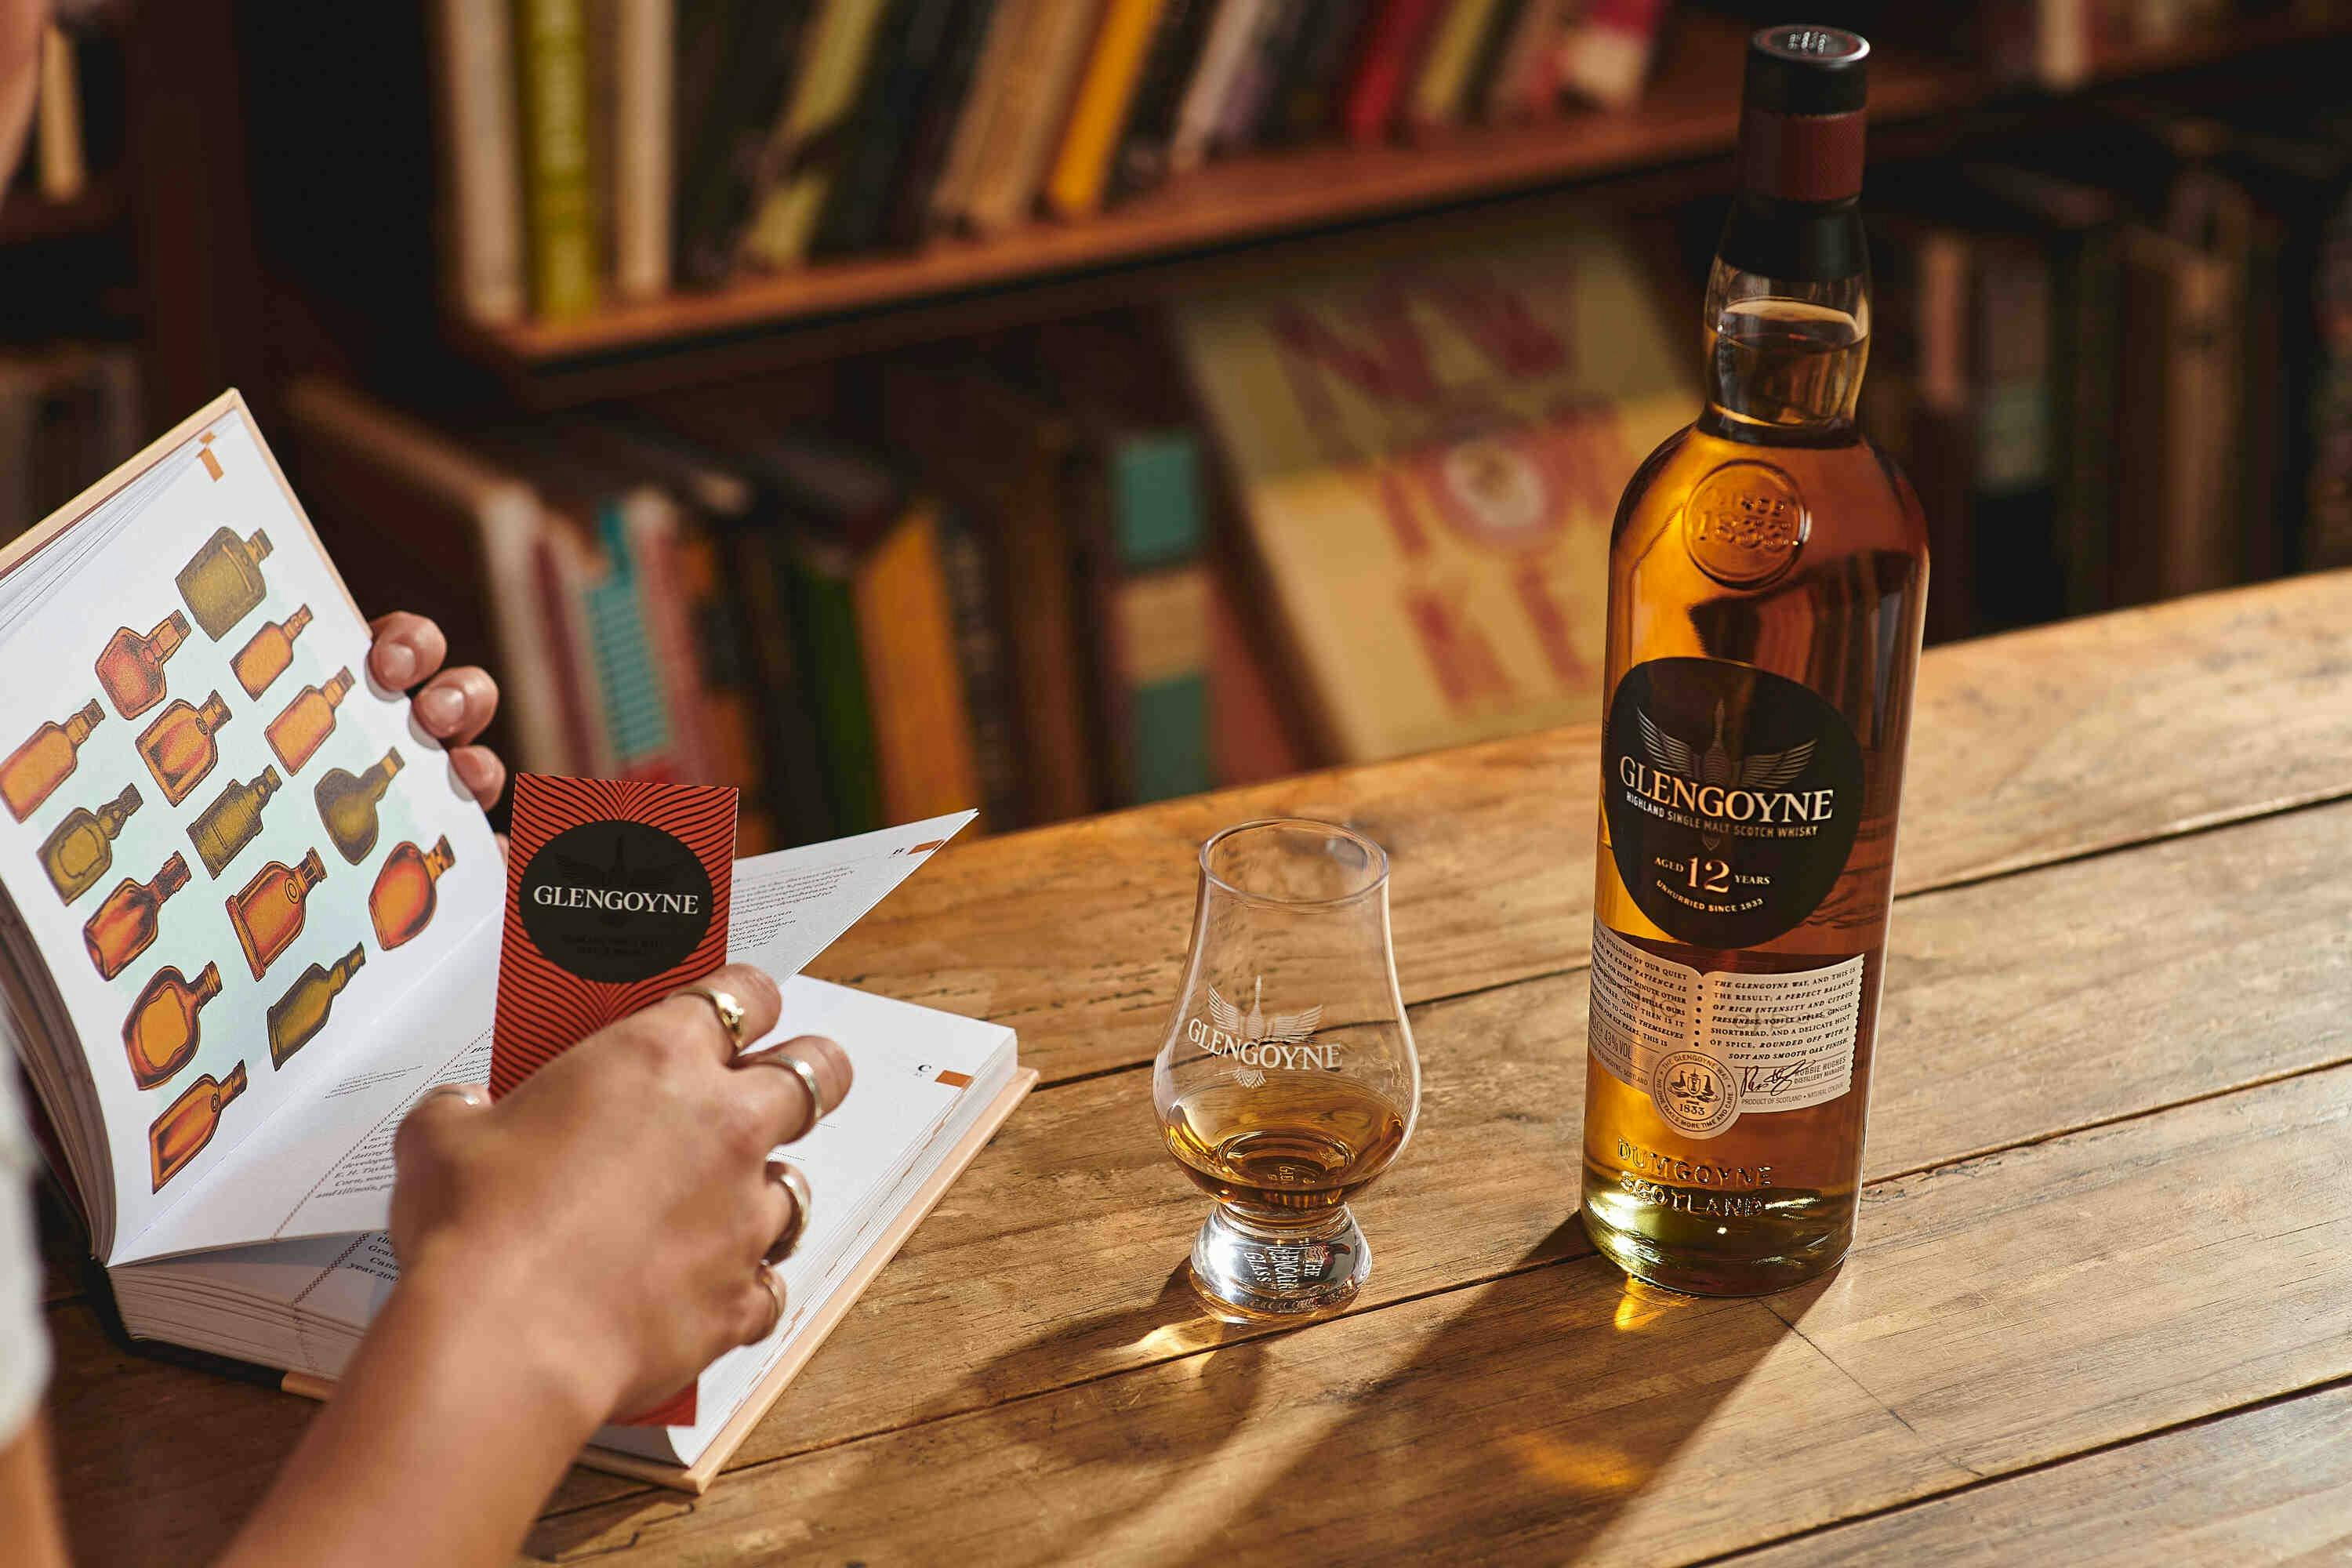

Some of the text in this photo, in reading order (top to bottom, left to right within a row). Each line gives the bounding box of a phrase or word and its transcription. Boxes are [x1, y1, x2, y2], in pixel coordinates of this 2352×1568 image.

[1620, 755, 1834, 823] GLENGOYNE
[1626, 791, 1818, 837] HIGHLAND SINGLE MALT SCOTCH WHISKY
[1654, 856, 1770, 893] AGED 12 YEARS
[533, 884, 699, 915] GLENGOYNE
[1656, 879, 1764, 913] UNHURRIED SINCE 1833
[1615, 956, 1633, 971] KNOW
[1635, 970, 1675, 989] PATIENCE
[1645, 962, 1661, 972] OUR
[1663, 968, 1688, 981] QUIET
[1813, 976, 1829, 985] AND
[1831, 970, 1848, 980] THIS
[1617, 972, 1632, 985] EVERY
[1634, 981, 1661, 996] MINUTE
[1661, 992, 1686, 1004] OTHER
[1785, 989, 1822, 1000] PERFECT
[1824, 978, 1855, 993] BALANCE
[1621, 998, 1639, 1011] ONLY
[1641, 1008, 1661, 1022] THEN
[1666, 1006, 1686, 1016] OURS
[1755, 1004, 1805, 1013] INTENSITY
[1808, 1000, 1825, 1009] AND
[1828, 991, 1853, 1004] CITRUS
[1613, 1015, 1621, 1025] SIX
[1642, 1033, 1660, 1044] THIS
[1639, 1018, 1685, 1040] THEMSELVES
[1799, 1022, 1832, 1033] DELICATE
[1835, 1014, 1850, 1025] HINT
[1188, 1018, 1343, 1071] GLENGOYNE
[1759, 1039, 1803, 1048] ROUNDED
[1806, 1035, 1822, 1044] OFF
[1825, 1029, 1844, 1039] WITH
[1619, 1040, 1632, 1060] VOL
[1773, 1051, 1806, 1060] SMOOTH
[917, 1064, 932, 1073] C
[1662, 1054, 1730, 1081] THE GLENGOYNE WAY
[1823, 1056, 1846, 1070] HUGHES
[1795, 1074, 1823, 1084] DISTILLERY
[1657, 1078, 1662, 1088] NO
[1662, 1104, 1680, 1122] TAKES
[1680, 1120, 1700, 1129] MORE
[1701, 1119, 1717, 1128] TIME
[1716, 1109, 1728, 1122] AND
[1726, 1092, 1734, 1109] CARE
[1679, 1103, 1705, 1116] 1833
[1741, 1097, 1767, 1105] PRODUCT
[1774, 1094, 1802, 1104] SCOTLAND
[1618, 1137, 1773, 1187] DUMGOYNE
[1619, 1171, 1764, 1217] SCOTLAND
[1243, 1252, 1272, 1283] GLASS
[1303, 1259, 1325, 1277] THE
